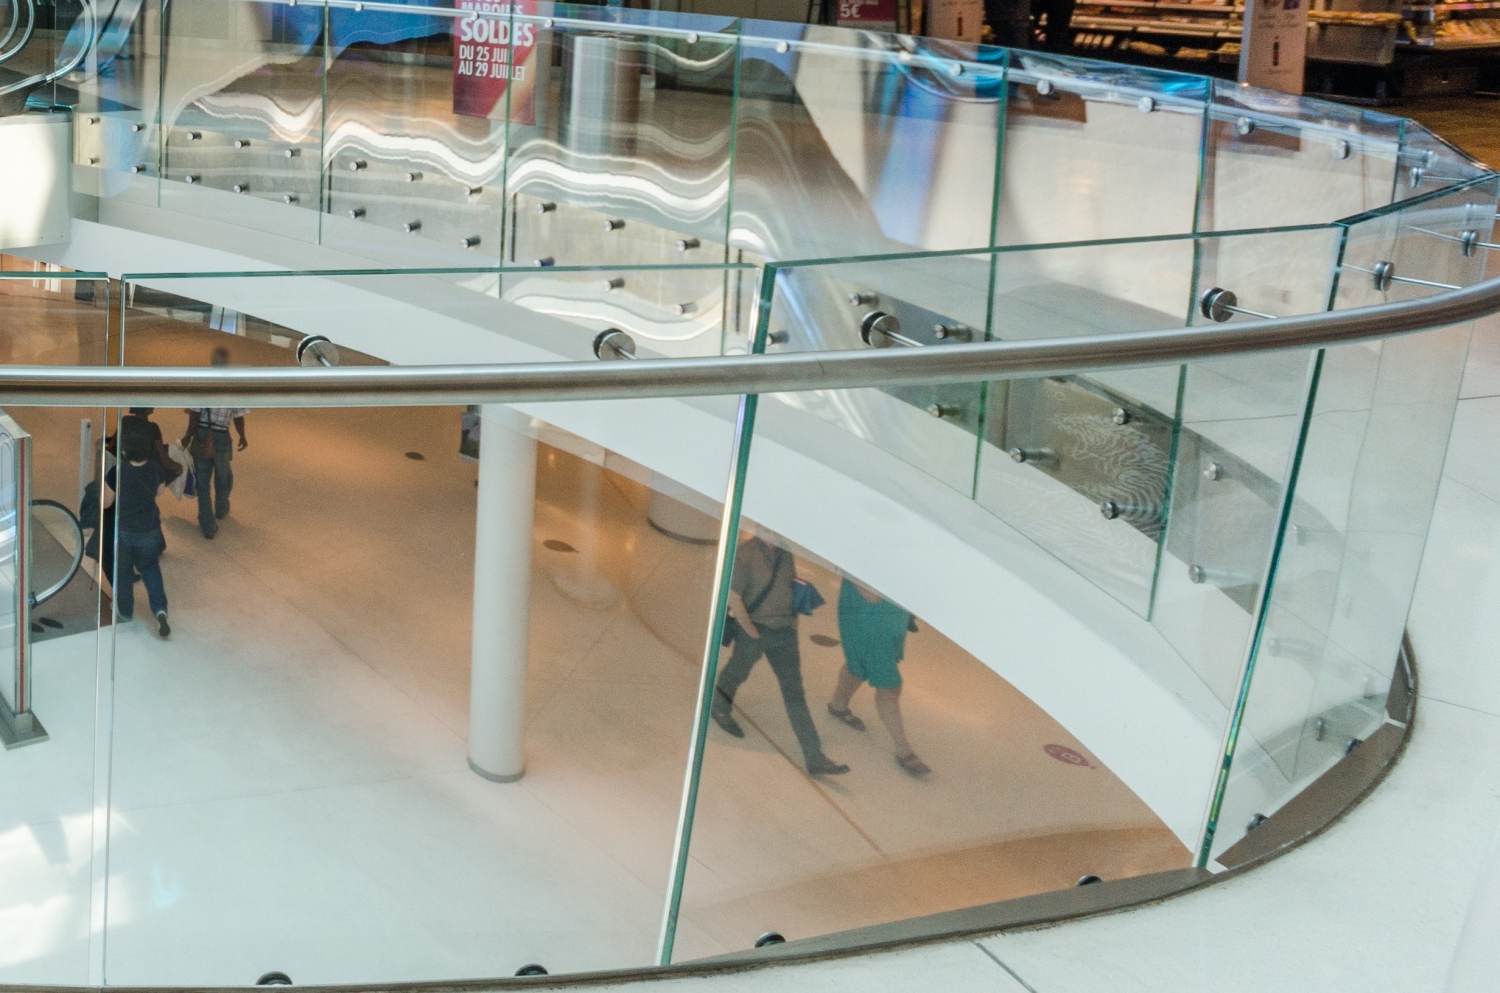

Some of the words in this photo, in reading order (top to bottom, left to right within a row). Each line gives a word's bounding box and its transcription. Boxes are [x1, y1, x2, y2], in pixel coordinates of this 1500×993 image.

[840, 4, 861, 19] 5€
[461, 17, 535, 47] SOLDES
[459, 45, 474, 60] DU
[476, 46, 490, 61] 25
[458, 60, 473, 76] AU
[475, 62, 488, 77] 29
